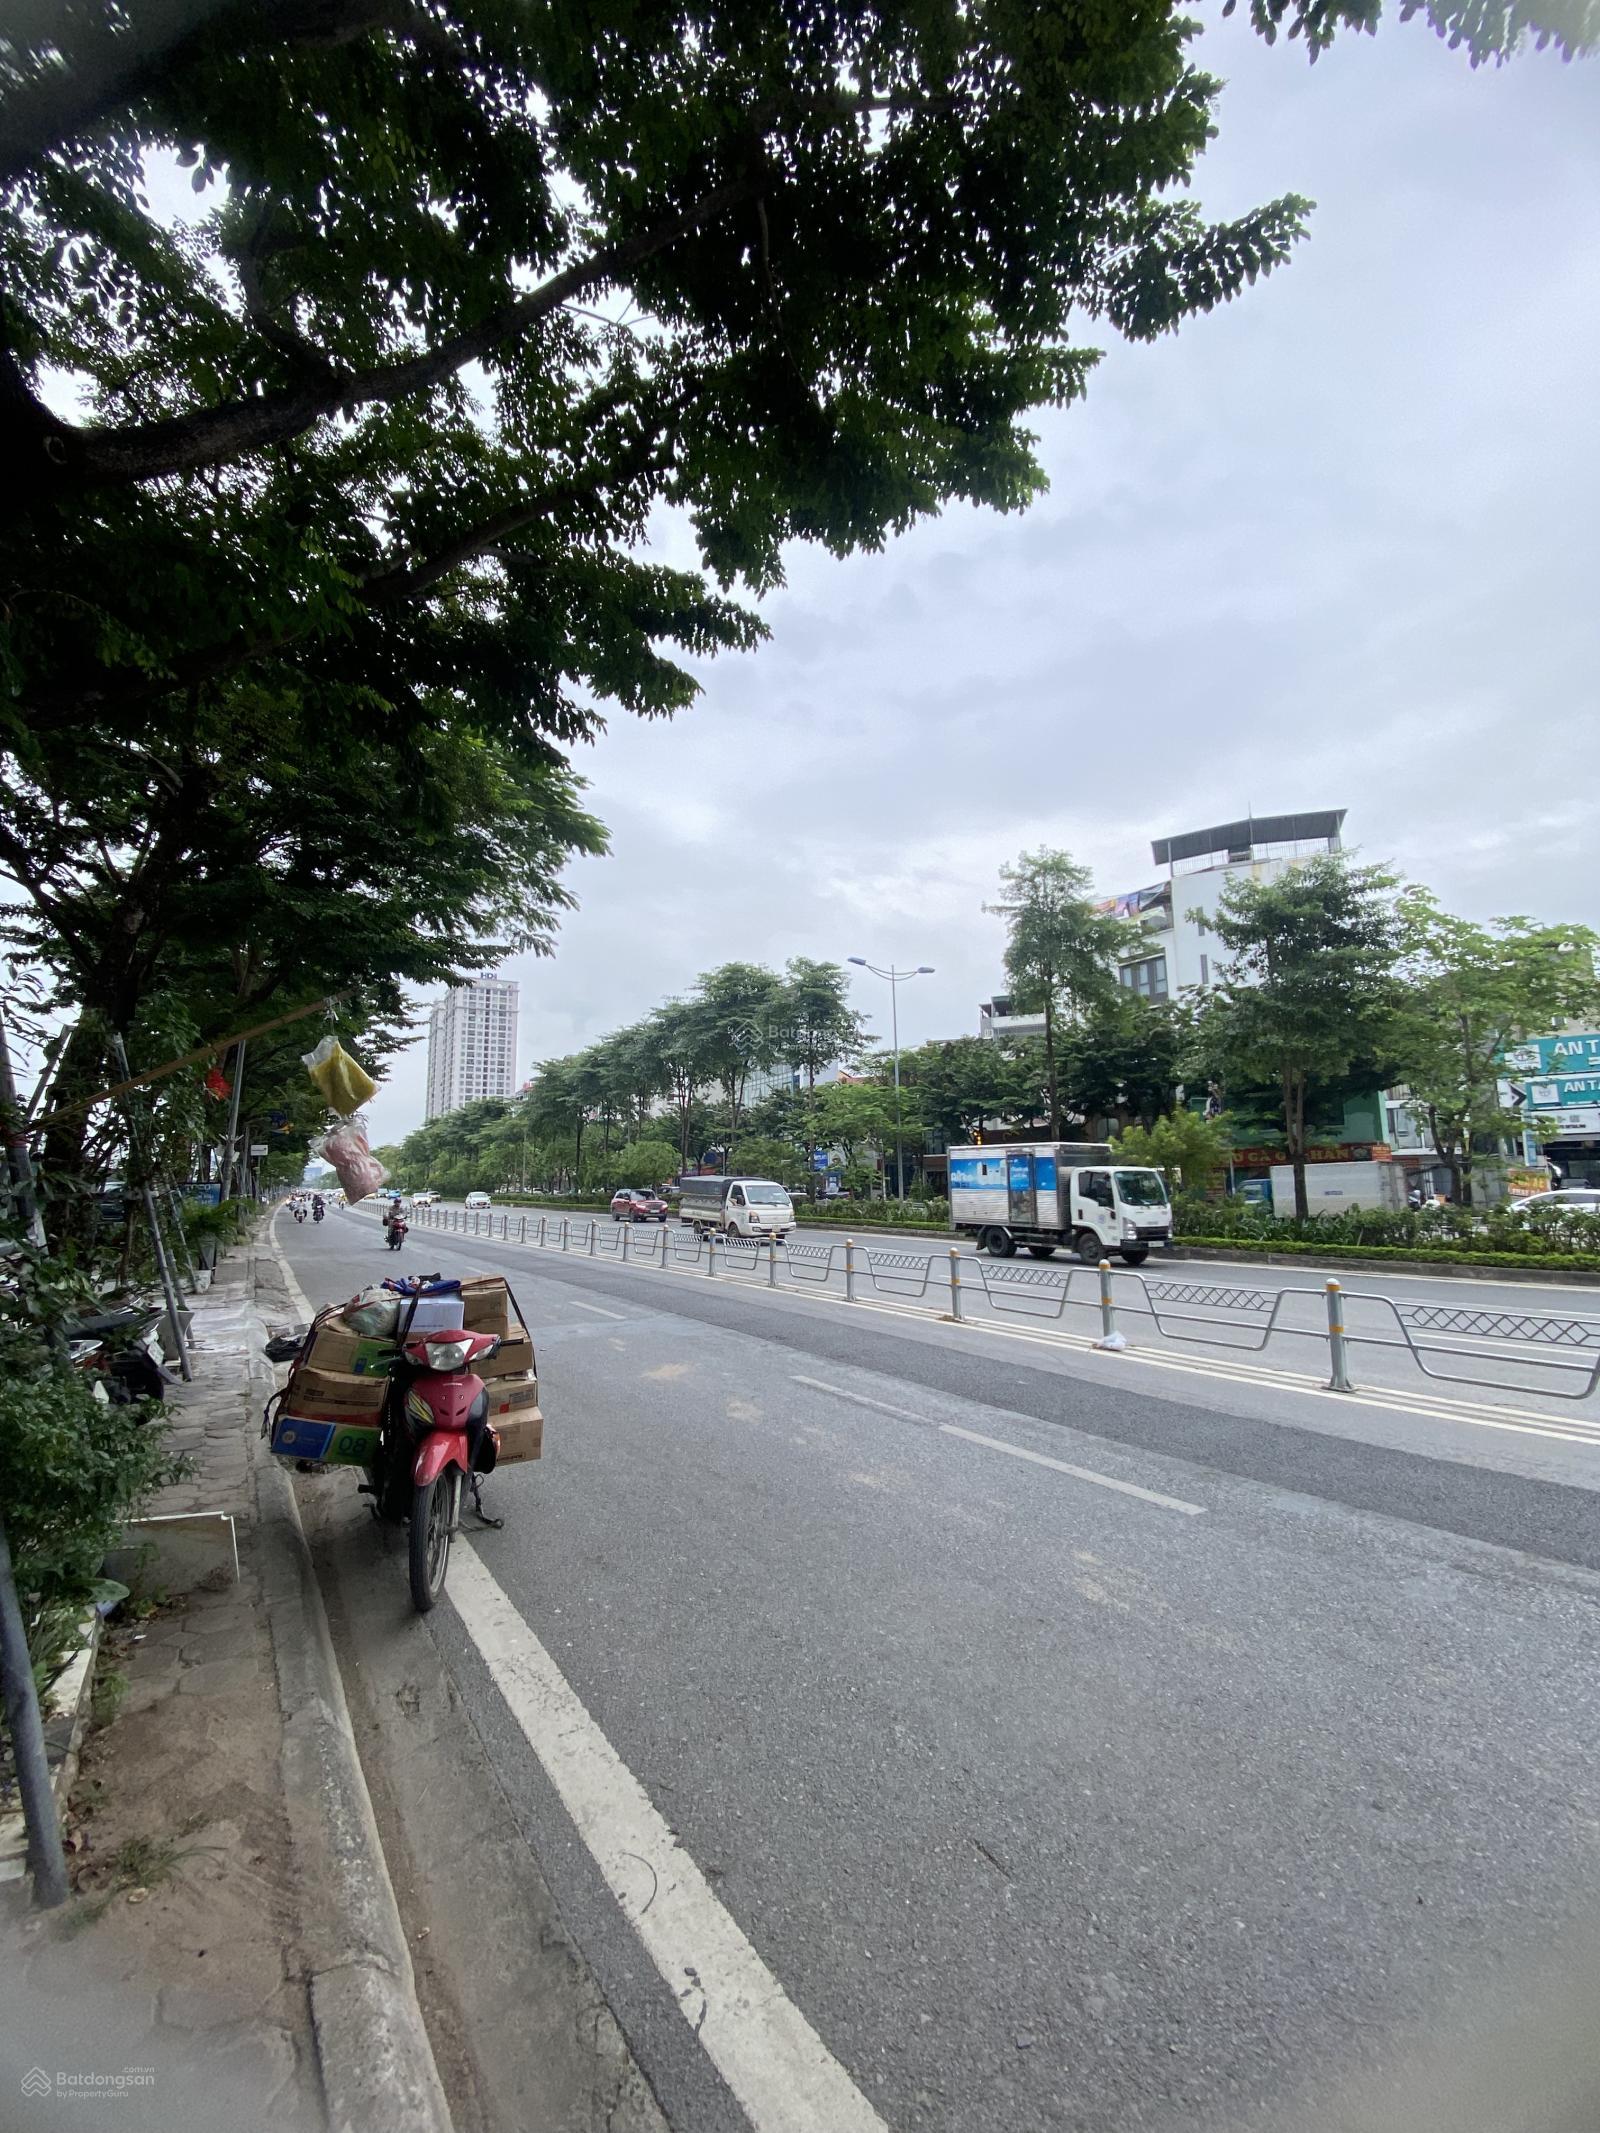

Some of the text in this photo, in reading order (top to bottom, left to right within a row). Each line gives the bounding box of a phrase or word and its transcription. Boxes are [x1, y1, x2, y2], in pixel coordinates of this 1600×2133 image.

[1553, 1041, 1583, 1056] AN
[1564, 1080, 1600, 1093] AN T
